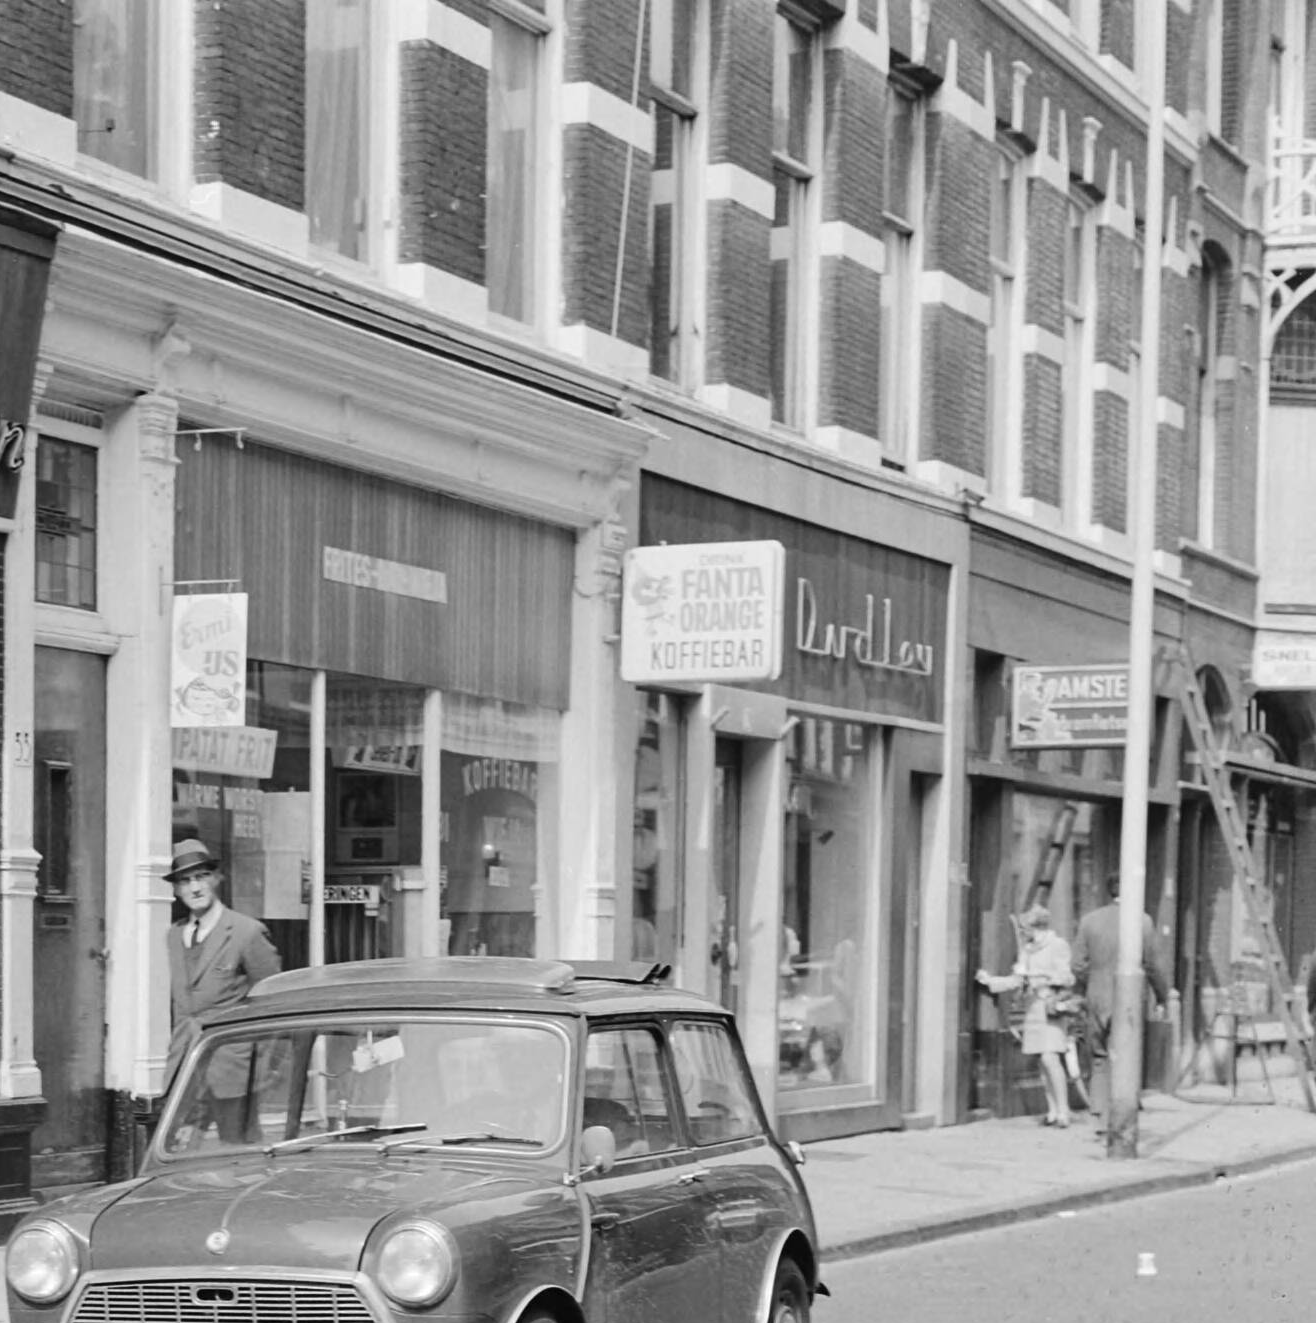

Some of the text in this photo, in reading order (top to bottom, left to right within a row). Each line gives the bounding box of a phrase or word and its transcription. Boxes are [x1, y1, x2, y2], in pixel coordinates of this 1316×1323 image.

[681, 566, 766, 600] FANTA
[679, 599, 765, 633] ORANGE
[650, 638, 765, 671] KOFFIEBAR
[1058, 673, 1129, 699] AMSTE
[178, 727, 272, 770] PATAT FRIT
